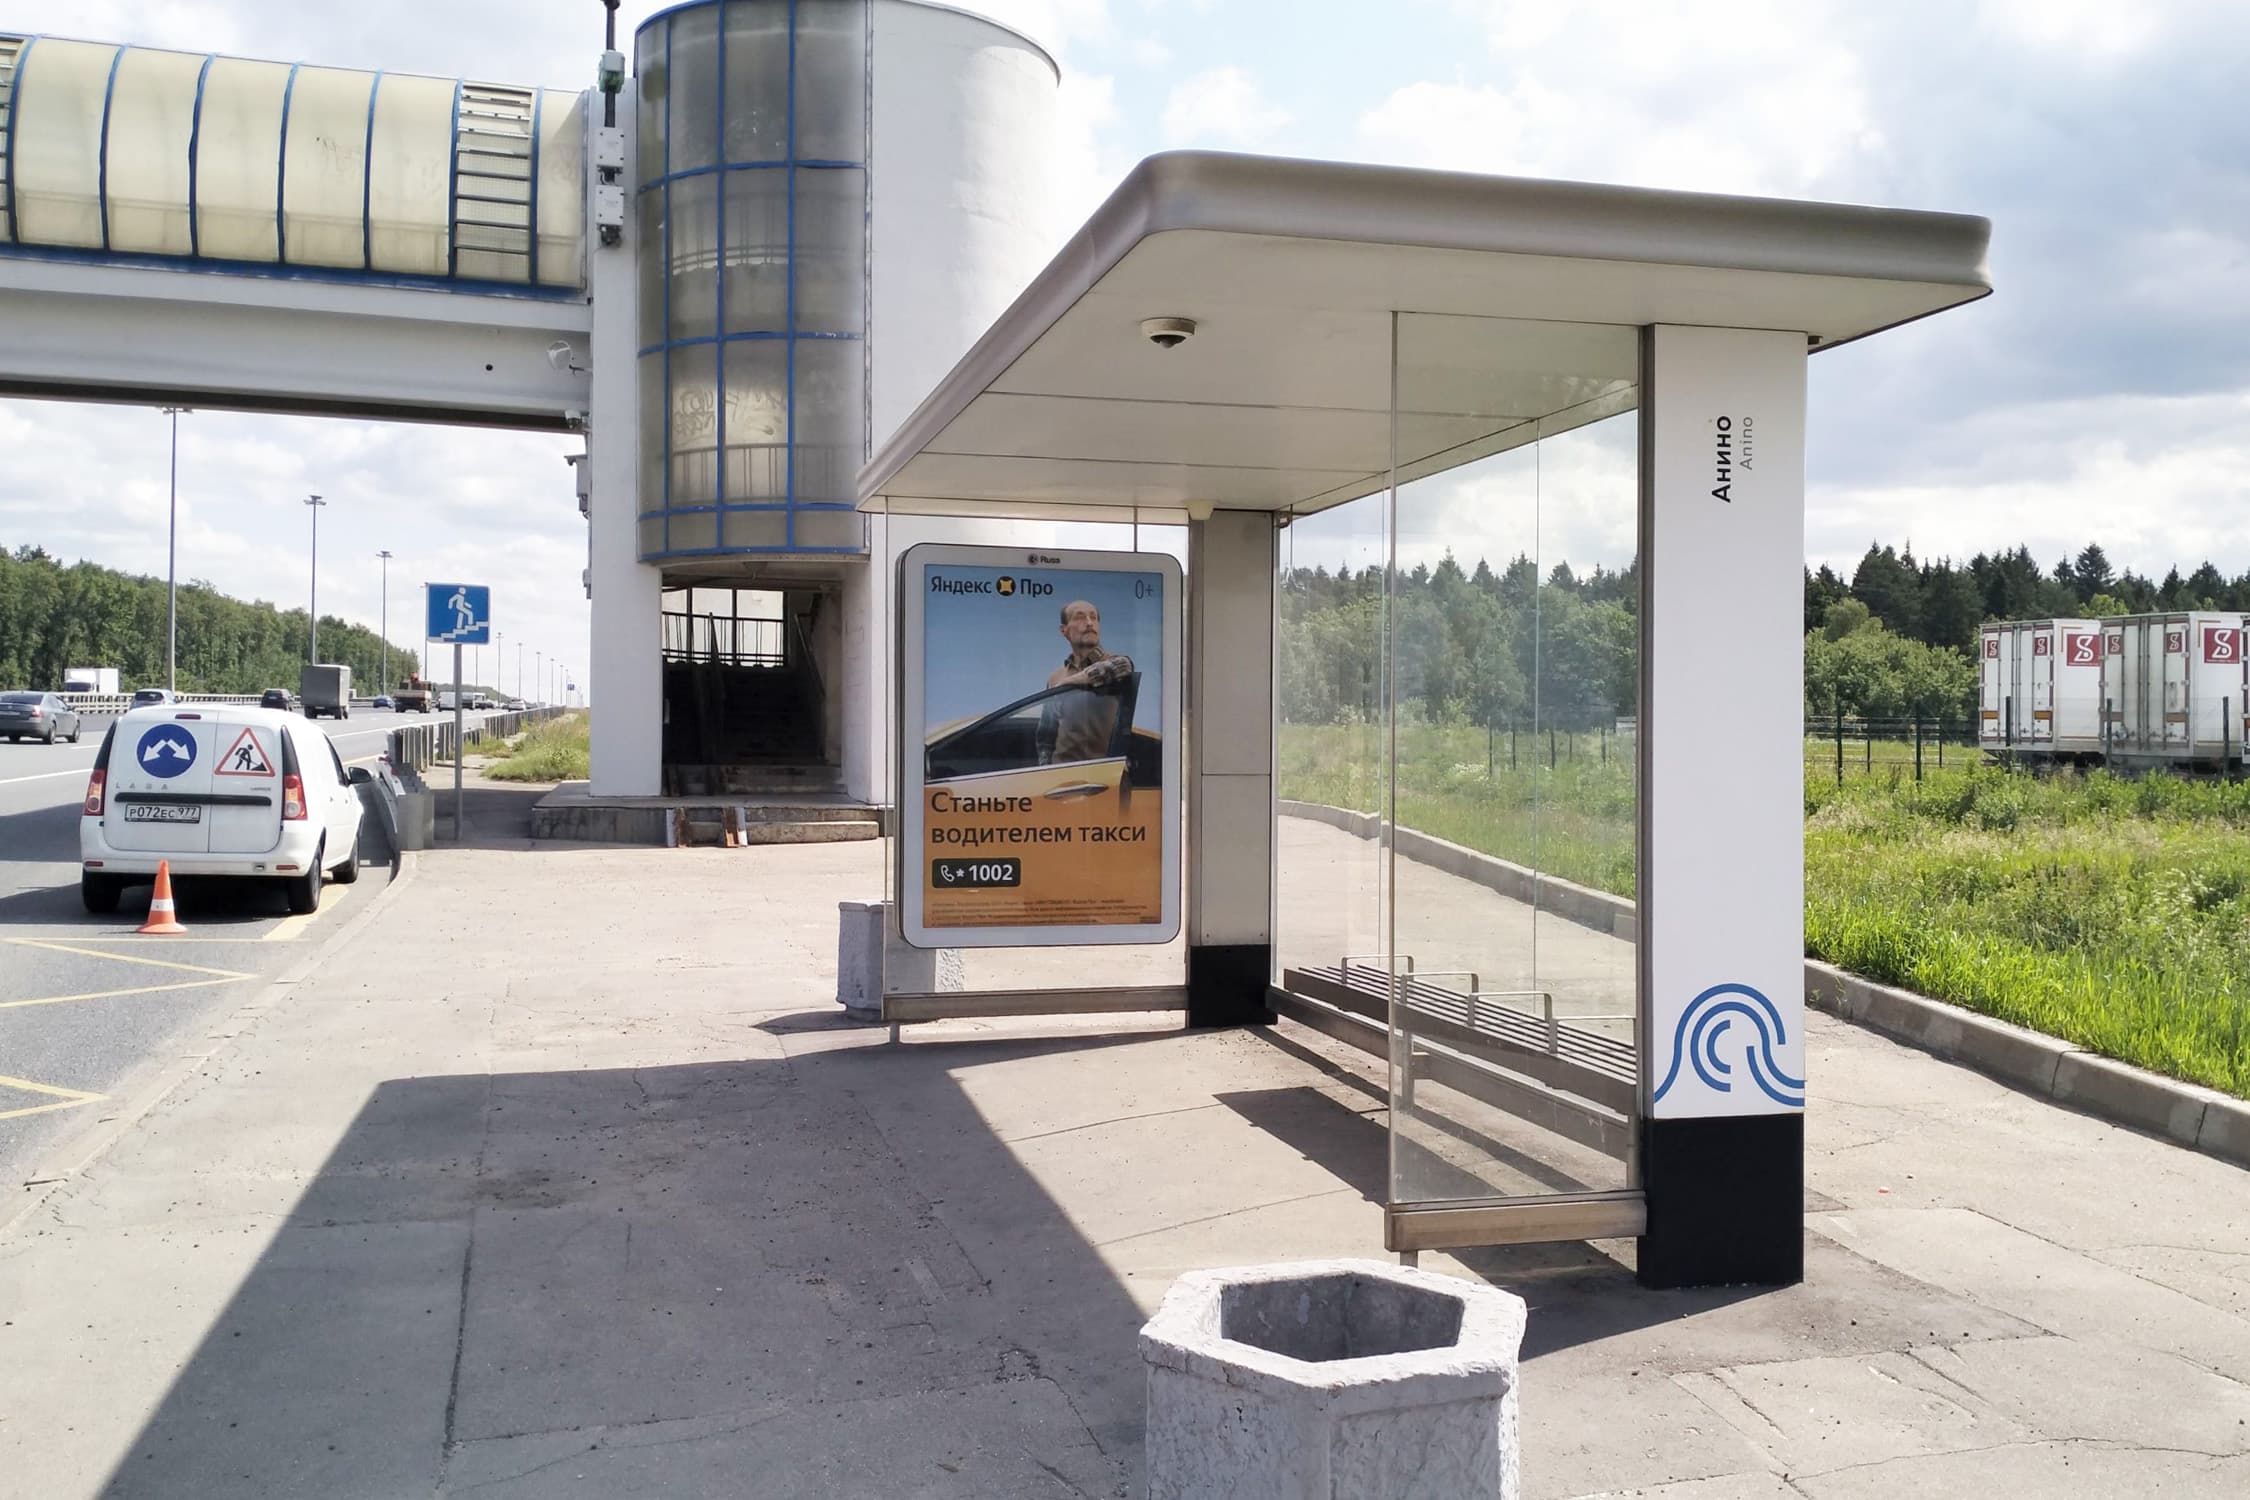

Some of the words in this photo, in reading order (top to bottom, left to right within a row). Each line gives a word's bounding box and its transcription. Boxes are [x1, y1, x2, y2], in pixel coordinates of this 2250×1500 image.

[1739, 416, 1754, 470] Anino
[1711, 416, 1732, 503] Анино
[931, 576, 992, 595] Яндекс
[1020, 578, 1053, 598] Про
[1135, 579, 1153, 599] 0+
[931, 792, 1033, 813] Станьте
[932, 825, 1072, 848] водителем
[1078, 825, 1146, 842] такси
